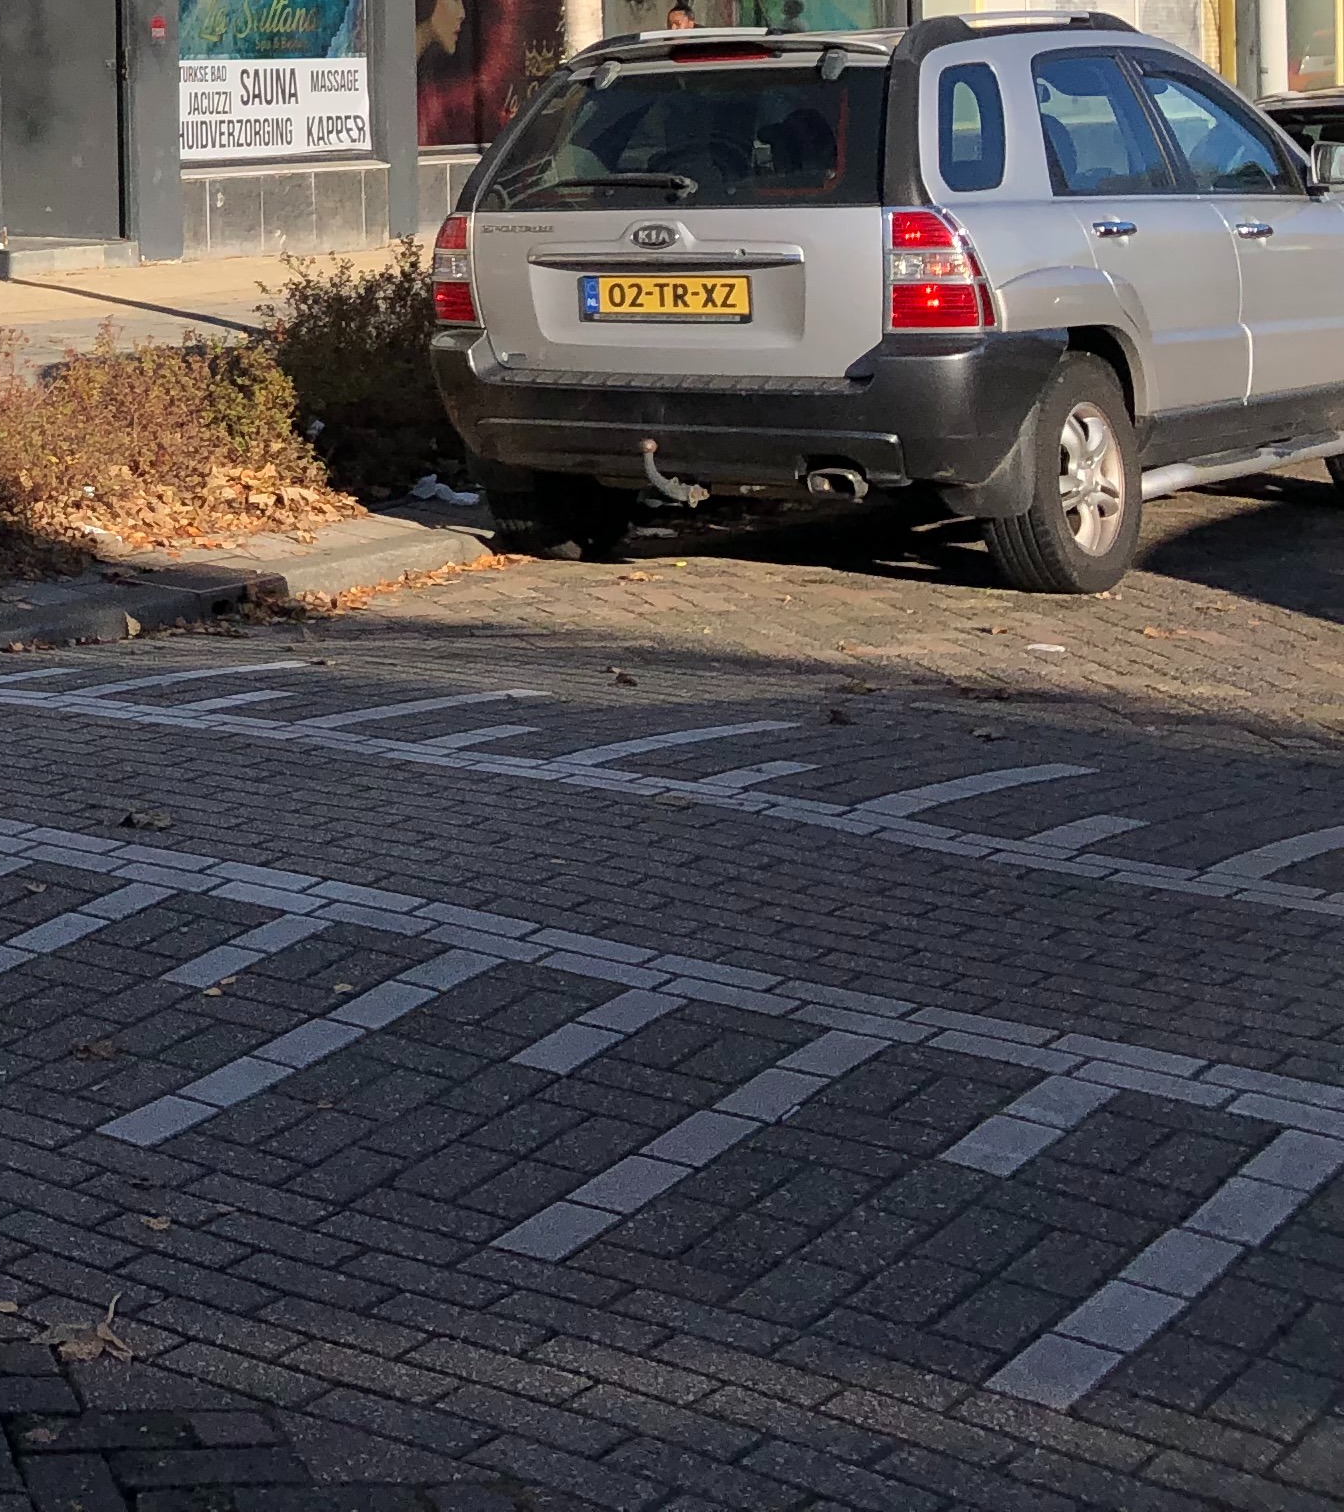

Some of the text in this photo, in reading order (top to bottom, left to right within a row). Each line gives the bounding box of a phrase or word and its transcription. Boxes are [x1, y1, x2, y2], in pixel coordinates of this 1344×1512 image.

[210, 65, 227, 83] BAD
[240, 68, 299, 106] SAUNA
[310, 69, 360, 93] MASSAGE
[187, 90, 232, 116] JACUZZI
[179, 117, 294, 150] HUIDVERZORGING
[306, 114, 367, 147] KAPPER
[637, 228, 672, 244] KIA
[607, 282, 738, 309] 02-TR-XZ
